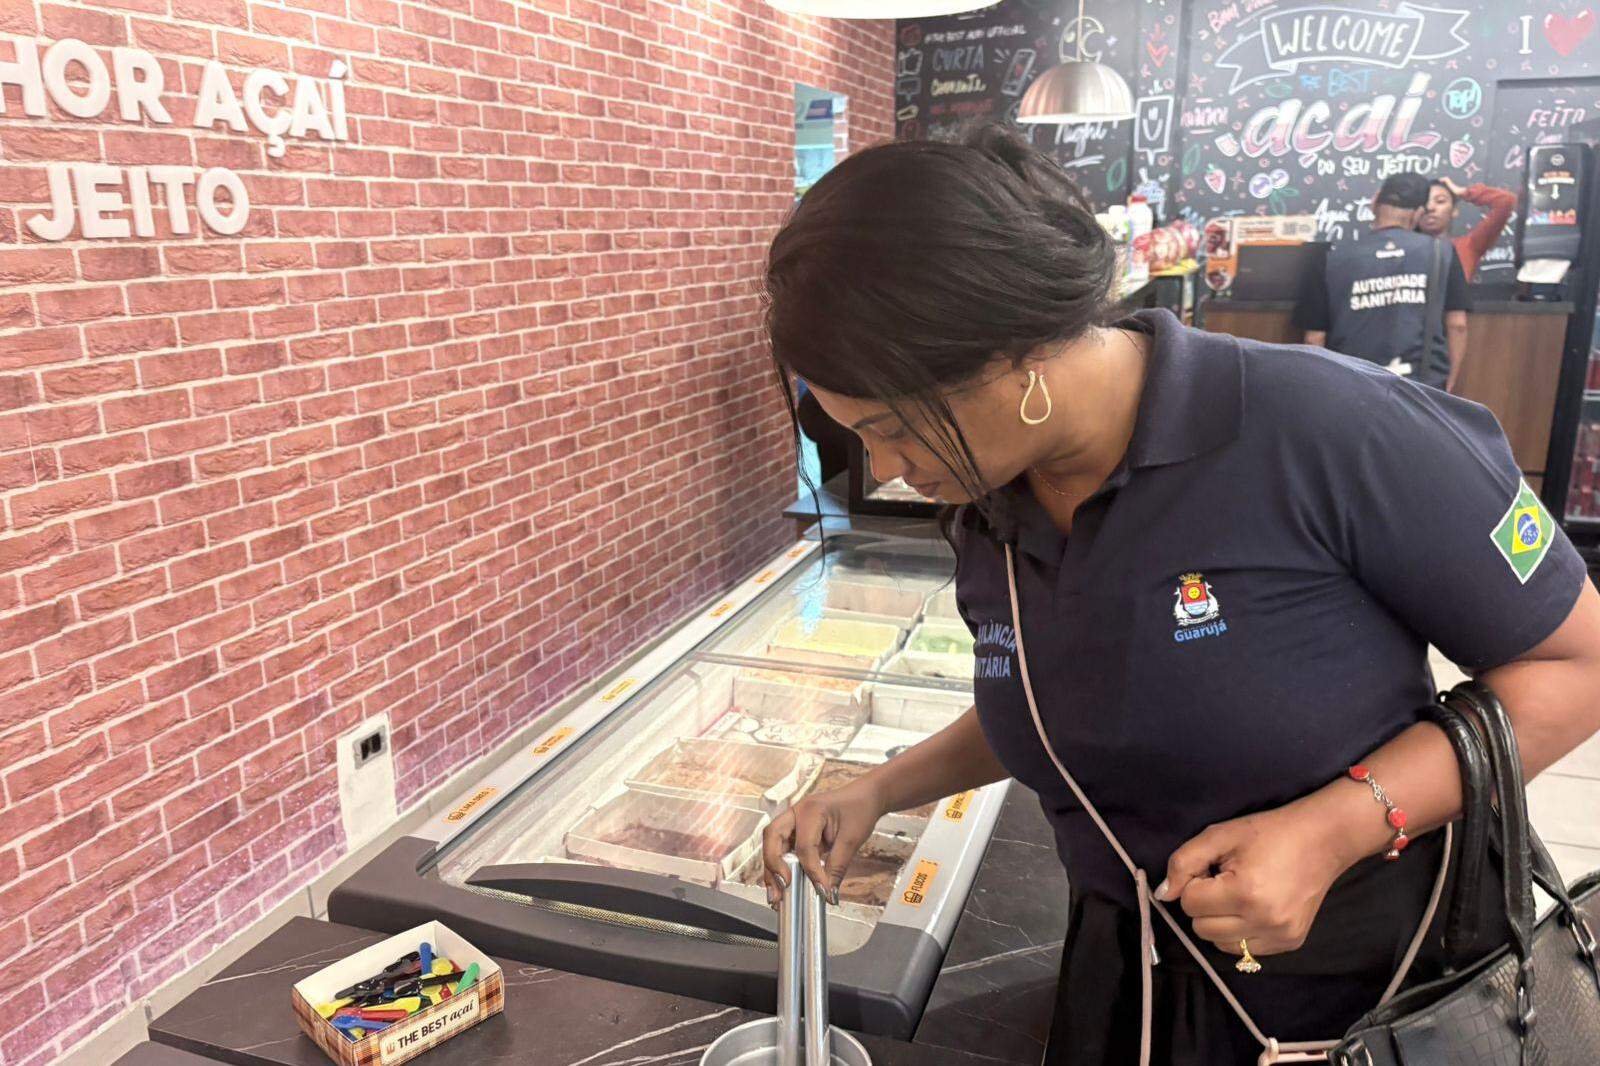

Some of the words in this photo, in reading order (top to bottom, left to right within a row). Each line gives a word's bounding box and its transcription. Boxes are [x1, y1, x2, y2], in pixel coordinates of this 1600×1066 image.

[1271, 15, 1410, 57] WELCOME
[1519, 15, 1534, 54] I
[193, 60, 348, 158] AÇAÍ
[1241, 71, 1442, 168] açaí
[1341, 156, 1371, 177] SEU
[26, 165, 250, 242] JEITO
[1352, 273, 1428, 295] AUTORIDADE
[1174, 619, 1227, 642] Guarujá
[397, 1030, 420, 1049] THE
[421, 1014, 449, 1037] BEST
[449, 999, 475, 1021] açaí
